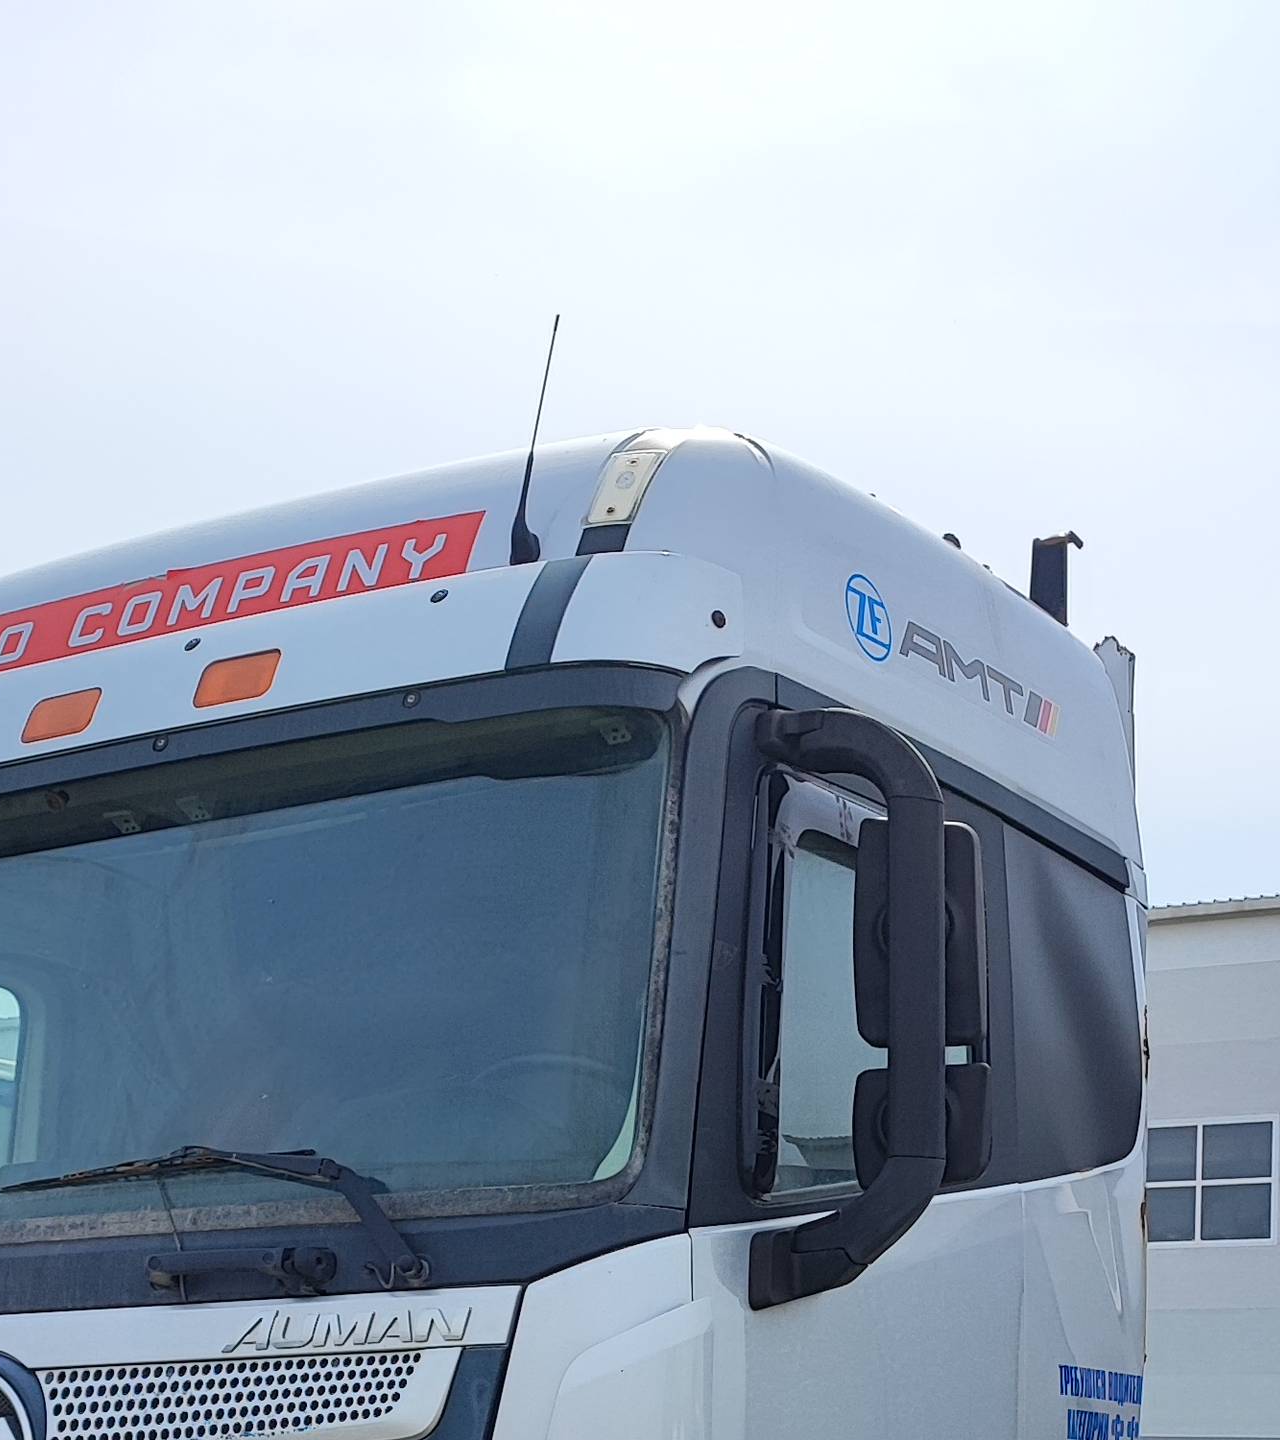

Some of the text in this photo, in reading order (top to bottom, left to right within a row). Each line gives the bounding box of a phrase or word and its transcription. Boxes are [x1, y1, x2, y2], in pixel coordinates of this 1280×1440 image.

[67, 533, 448, 648] COMPANY
[899, 620, 1024, 716] AMT
[221, 1307, 472, 1353] AUMAN
